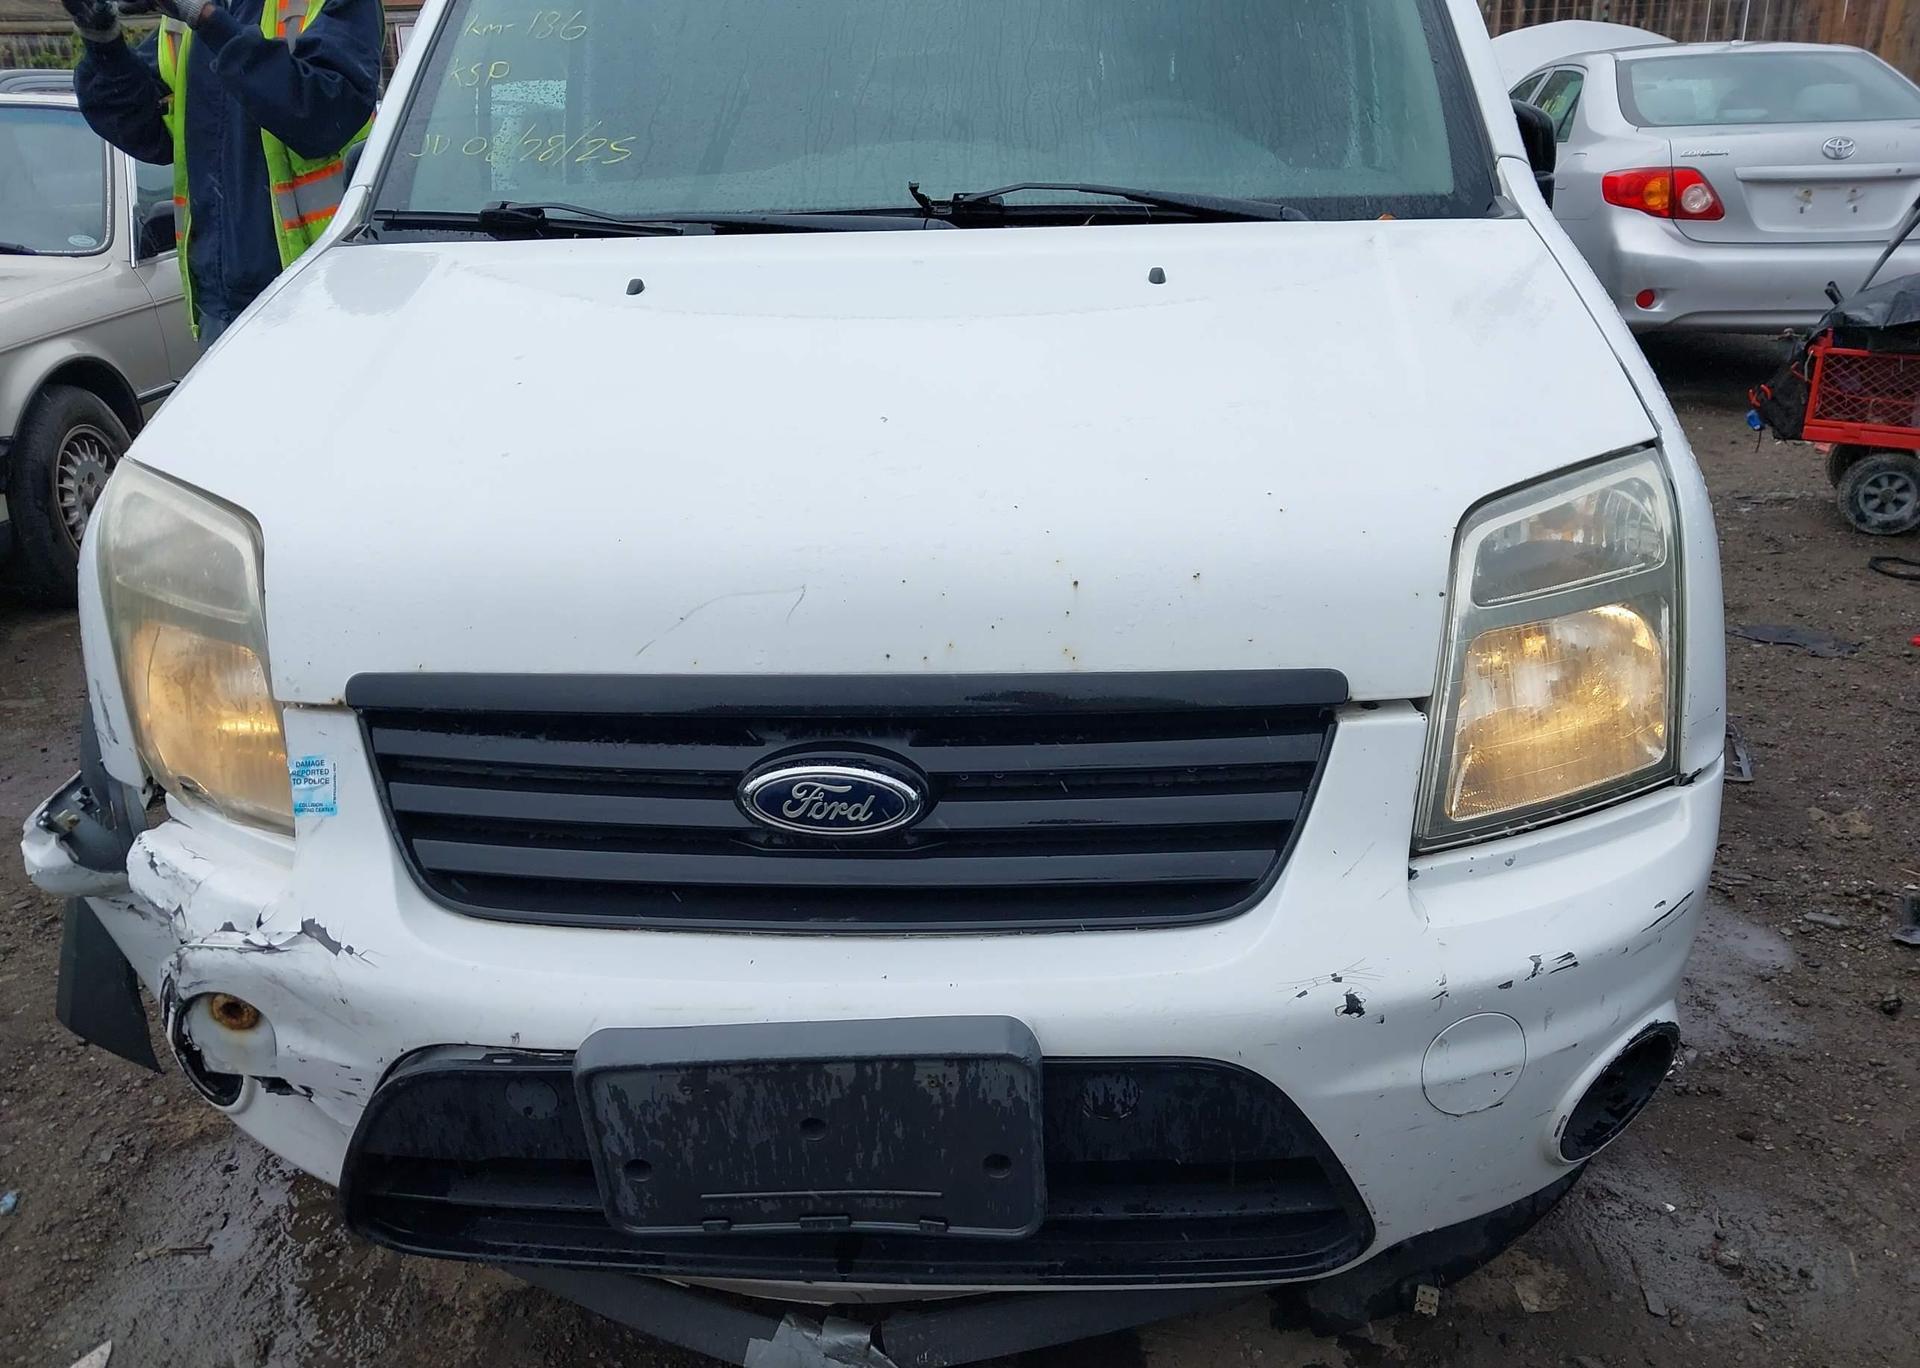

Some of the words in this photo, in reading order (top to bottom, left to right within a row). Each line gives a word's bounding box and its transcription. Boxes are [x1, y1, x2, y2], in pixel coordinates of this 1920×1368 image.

[295, 760, 325, 768] DAMAGE
[292, 778, 302, 786] TO
[303, 777, 330, 785] POLICE
[782, 781, 876, 822] Ford
